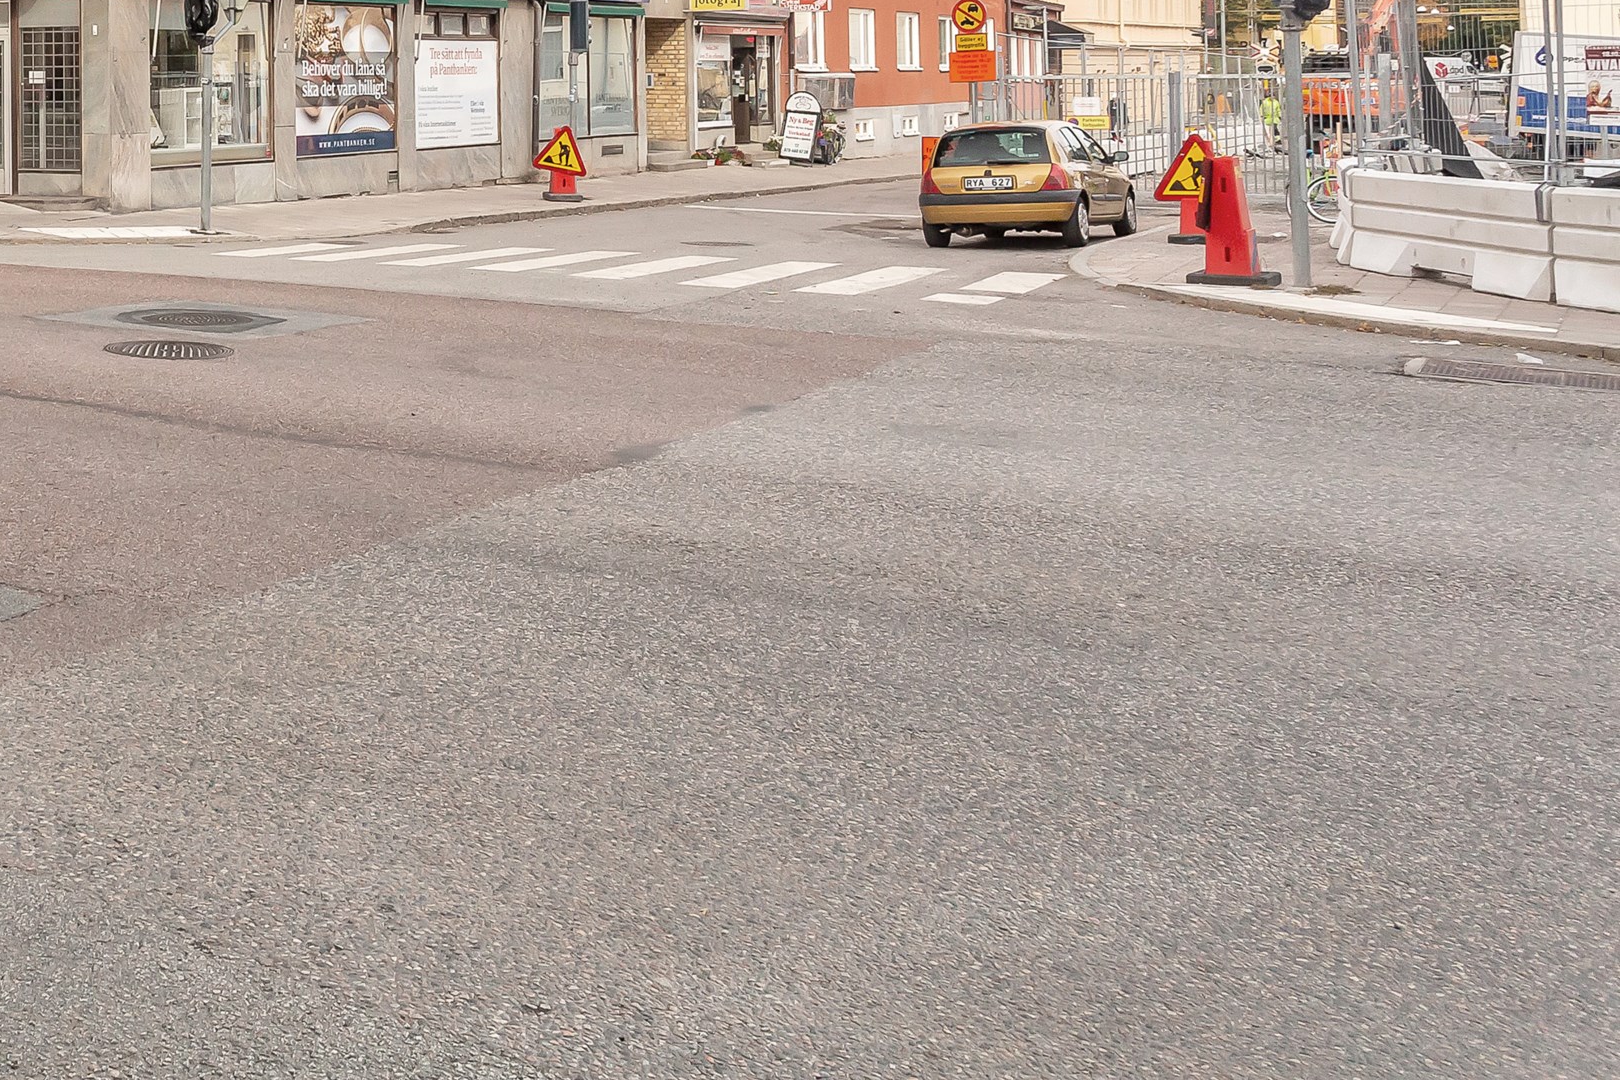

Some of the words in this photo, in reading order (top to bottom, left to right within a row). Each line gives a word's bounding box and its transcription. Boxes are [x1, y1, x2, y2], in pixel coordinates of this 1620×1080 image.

[429, 48, 441, 60] Tre
[442, 47, 454, 60] sätt
[454, 48, 464, 60] att
[464, 47, 482, 62] fynda
[302, 59, 341, 76] Behöver
[342, 60, 354, 76] du
[355, 58, 375, 76] låna
[375, 58, 386, 76] så
[430, 62, 438, 78] på
[1450, 66, 1464, 75] dpd
[1586, 58, 1620, 71] VIVA
[302, 81, 319, 97] ska
[320, 80, 335, 97] det
[337, 83, 357, 97] vara
[358, 78, 388, 99] billigt!
[967, 179, 985, 187] RYA
